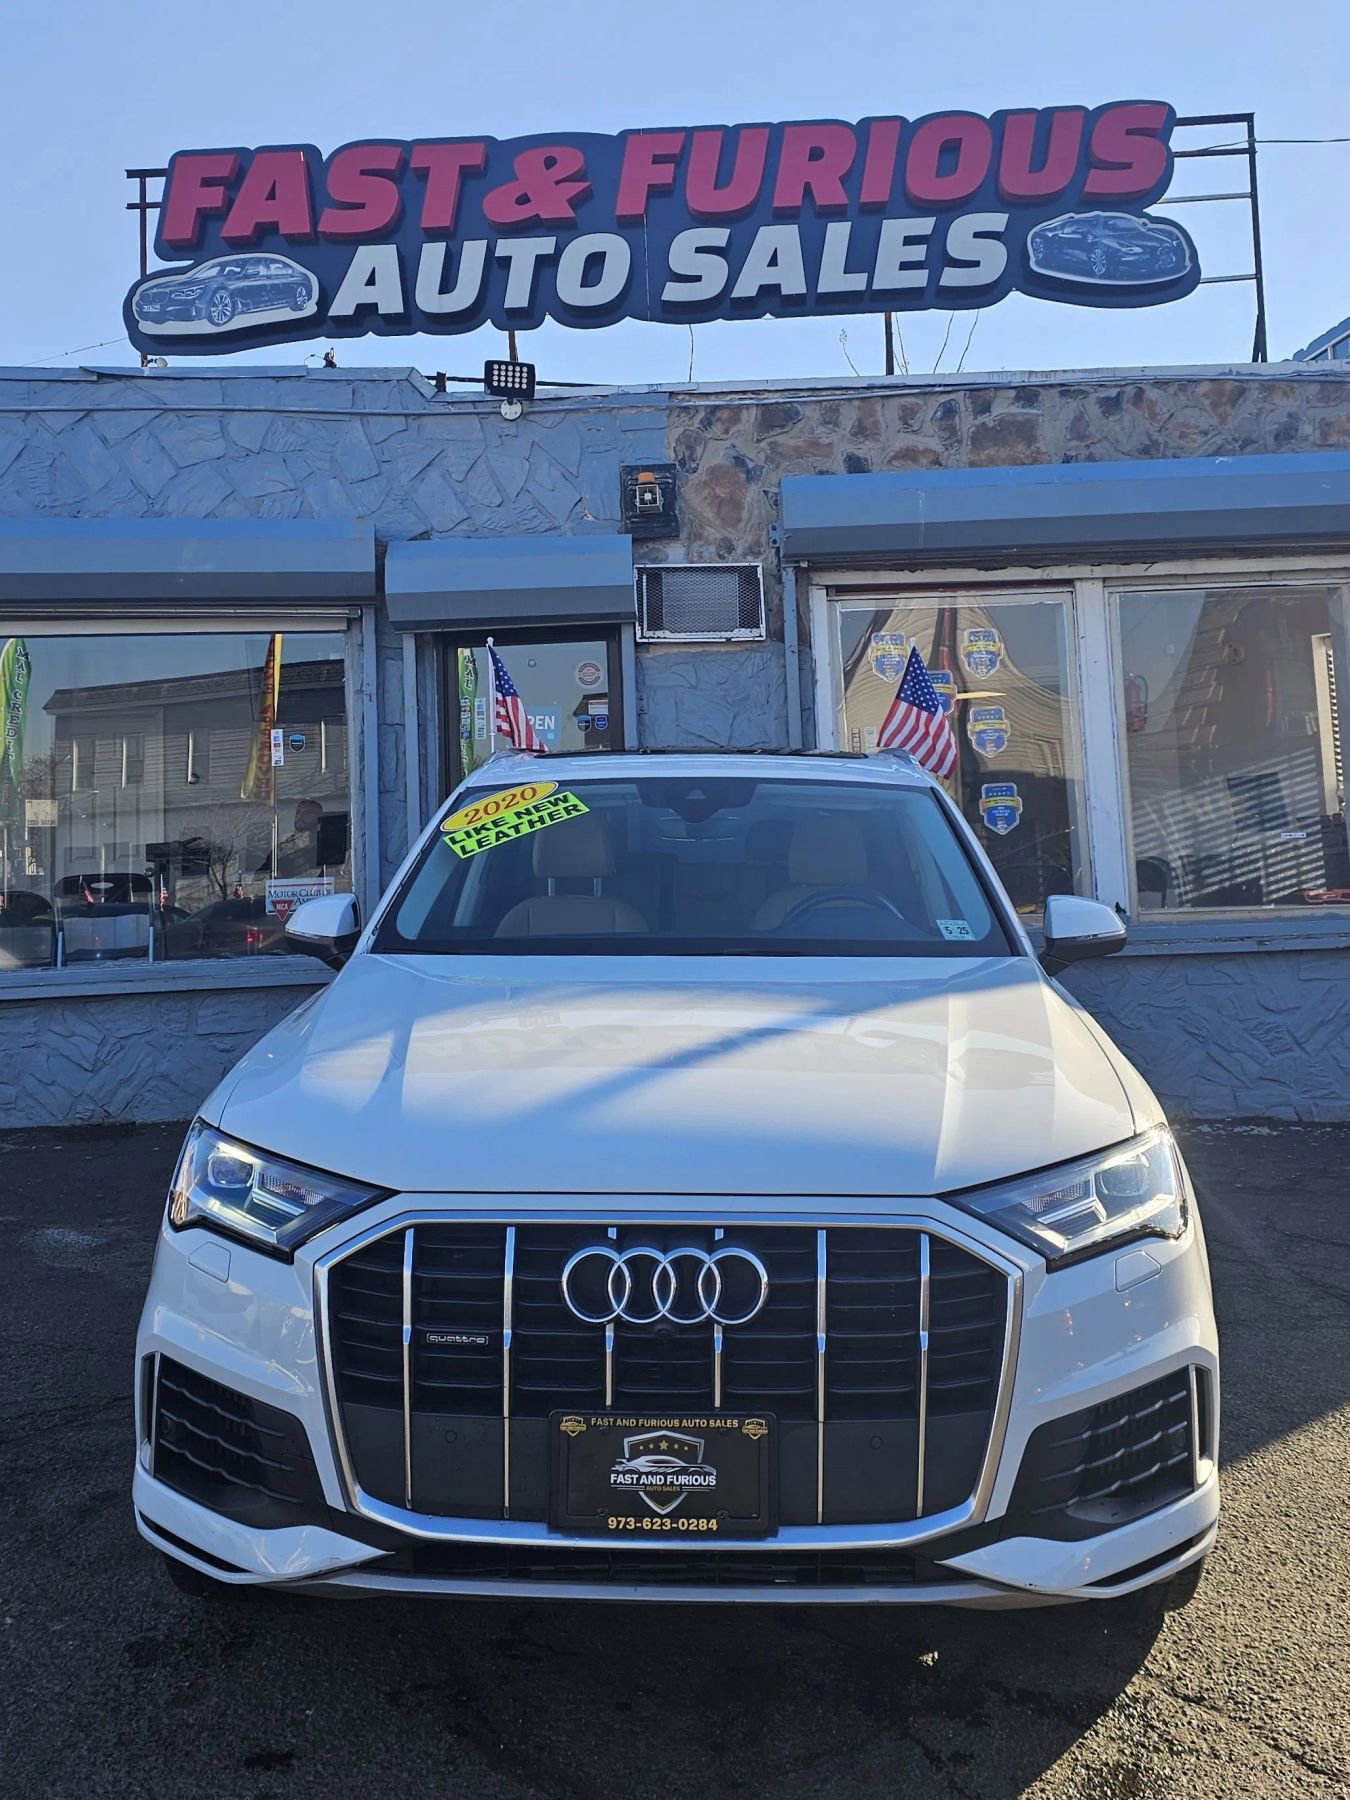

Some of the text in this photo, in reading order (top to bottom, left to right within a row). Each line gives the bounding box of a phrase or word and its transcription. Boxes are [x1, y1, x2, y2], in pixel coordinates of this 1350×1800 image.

[162, 104, 1170, 245] FAST & FURIOUS
[329, 212, 1010, 316] AUTO SALES
[527, 715, 556, 730] PEN
[464, 787, 537, 825] 2020
[448, 794, 570, 845] LIKE NEW
[460, 804, 582, 856] LEATHER
[429, 1335, 486, 1344] quattro
[591, 1417, 615, 1427] FAST
[615, 1418, 636, 1427] AND
[638, 1418, 680, 1428] FURIOUS
[682, 1418, 707, 1428] AUTO
[709, 1419, 739, 1429] SALES
[610, 1473, 717, 1486] FAST AND FURIOUS
[608, 1516, 718, 1531] 973-623-0284
